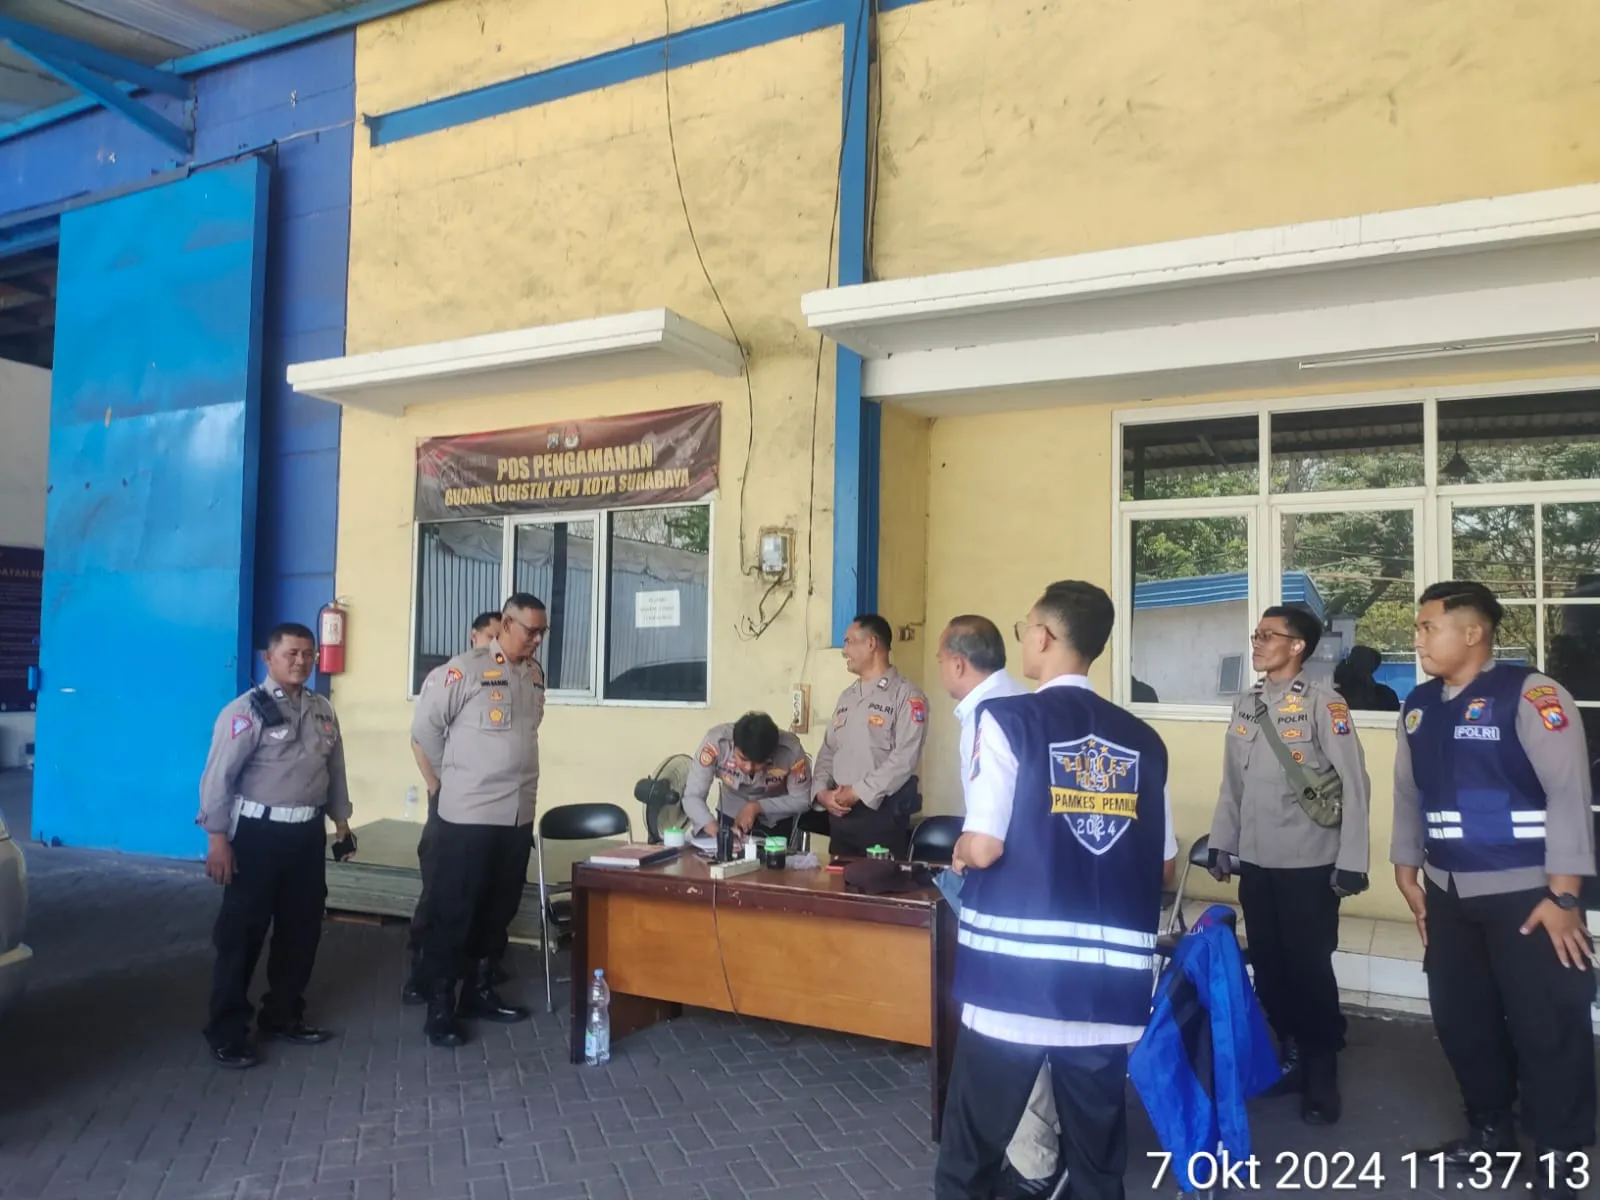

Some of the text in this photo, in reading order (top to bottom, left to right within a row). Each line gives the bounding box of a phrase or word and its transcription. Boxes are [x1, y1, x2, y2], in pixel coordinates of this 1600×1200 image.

[497, 443, 653, 481] POS PENGAMANAN
[445, 467, 690, 506] GUDANG LOGISTIK KPU KOTA SURABAYA
[868, 703, 894, 715] POLRI
[1278, 714, 1308, 724] POLRI
[1456, 726, 1498, 739] POLRI
[1055, 793, 1096, 810] PAMKES
[1076, 818, 1116, 837] 2024
